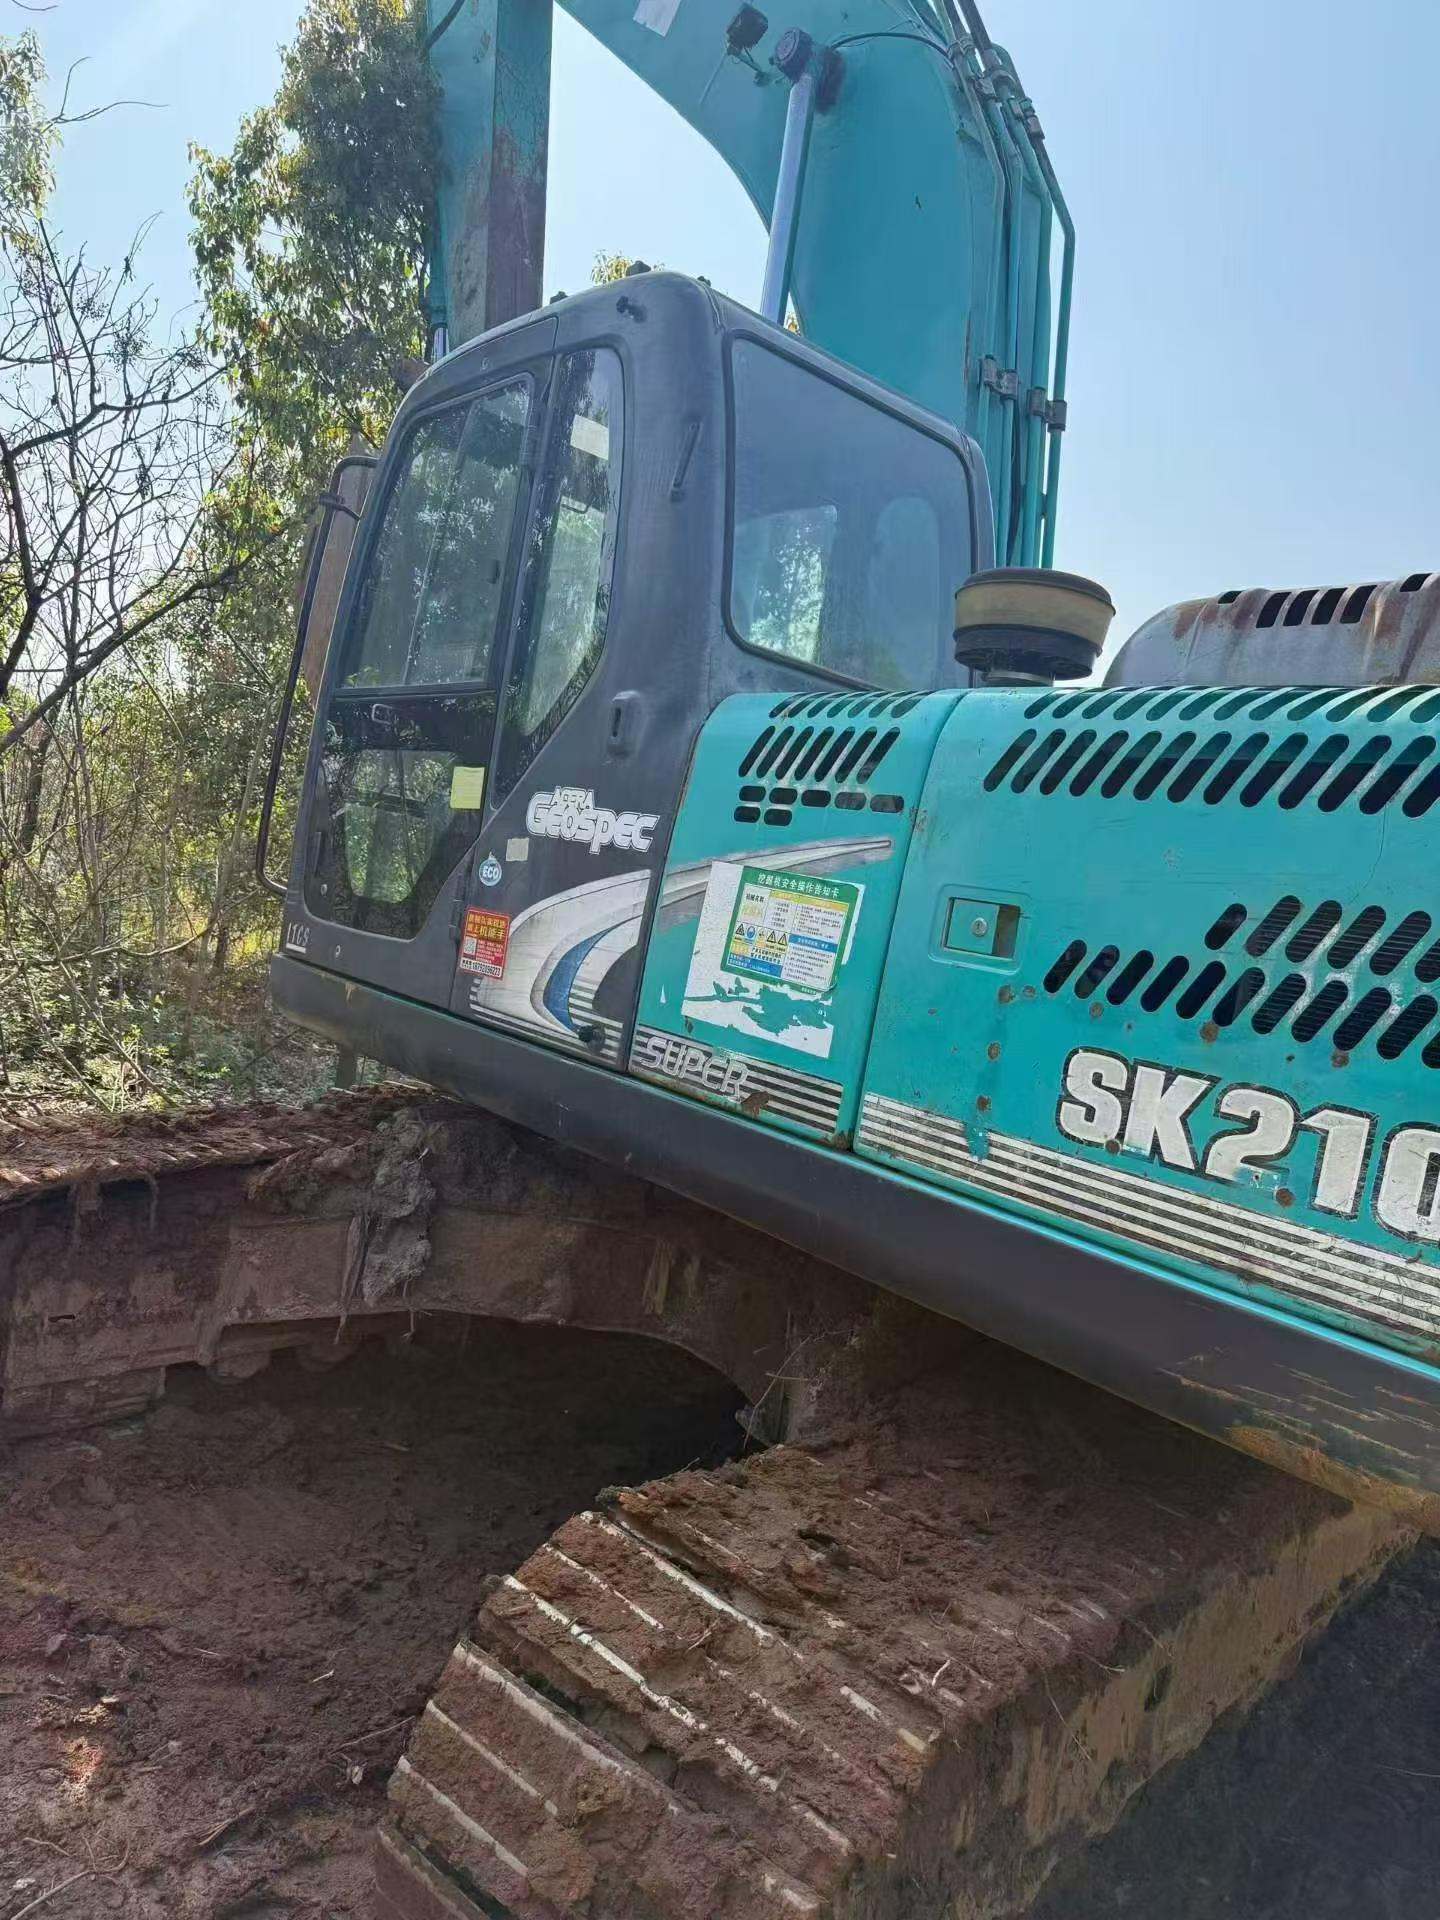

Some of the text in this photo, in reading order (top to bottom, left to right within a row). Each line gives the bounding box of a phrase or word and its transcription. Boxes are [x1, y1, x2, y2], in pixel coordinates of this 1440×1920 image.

[482, 865, 499, 879] ECO
[758, 873, 839, 898] 挖掘机安全操作告知卡
[640, 1036, 749, 1104] SUPER
[1057, 1046, 1440, 1244] SK210
